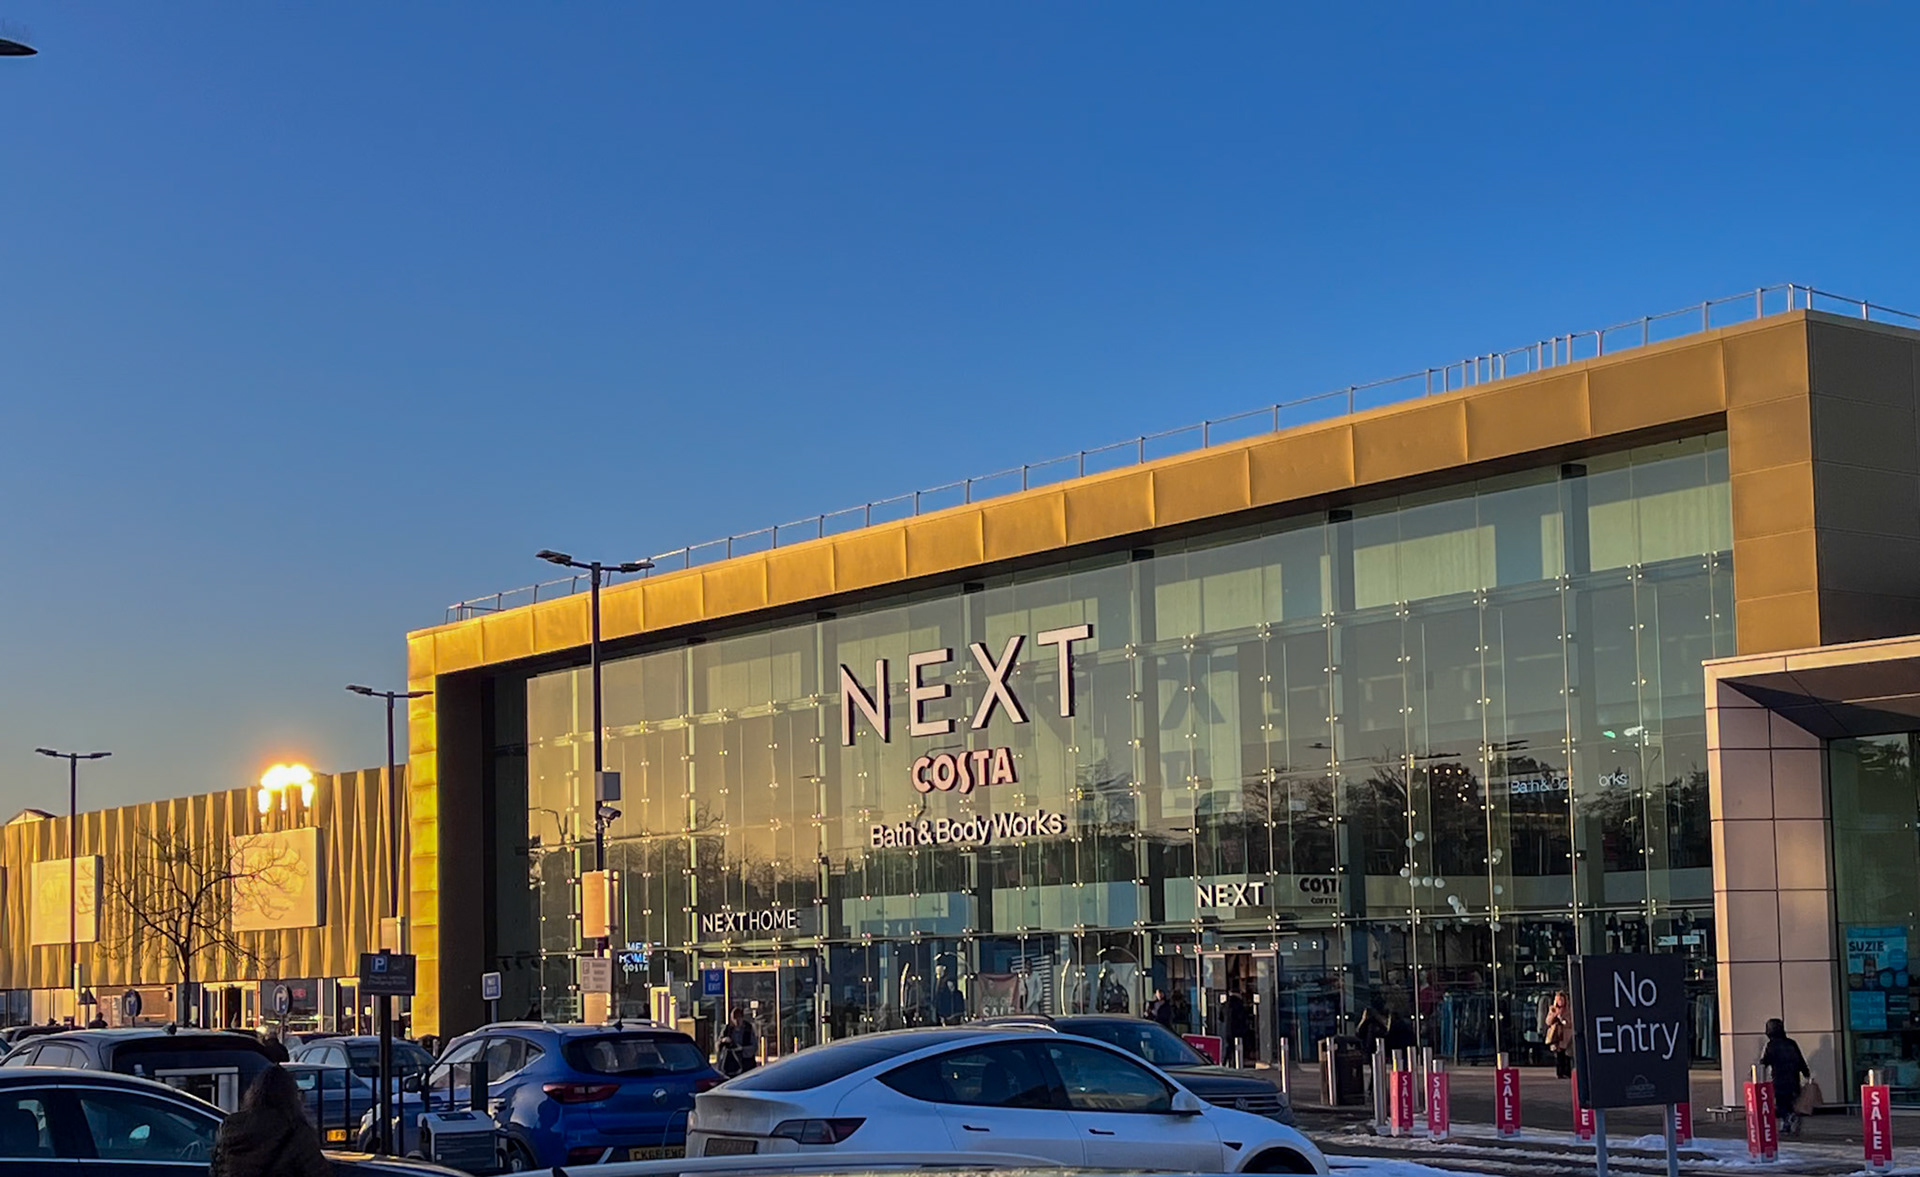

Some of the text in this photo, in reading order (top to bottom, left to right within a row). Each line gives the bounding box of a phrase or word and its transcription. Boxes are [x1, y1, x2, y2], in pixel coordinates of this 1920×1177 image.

[840, 624, 1093, 746] NEXT
[911, 747, 1018, 794] COSTA
[1598, 772, 1628, 787] orks
[870, 810, 1068, 848] Bath & Body Works
[1197, 881, 1268, 908] NEXT
[702, 909, 797, 933] NEXT HOME
[374, 957, 385, 970] P
[1848, 941, 1885, 952] SUZIE
[1613, 970, 1657, 1008] No
[1595, 1017, 1680, 1060] Entry
[1401, 1074, 1409, 1120] SALE
[1432, 1076, 1441, 1123] SALE
[1502, 1072, 1513, 1121] SALE
[1746, 1087, 1757, 1143] SALE
[1760, 1086, 1772, 1142] SALE
[1871, 1091, 1883, 1150] SALE
